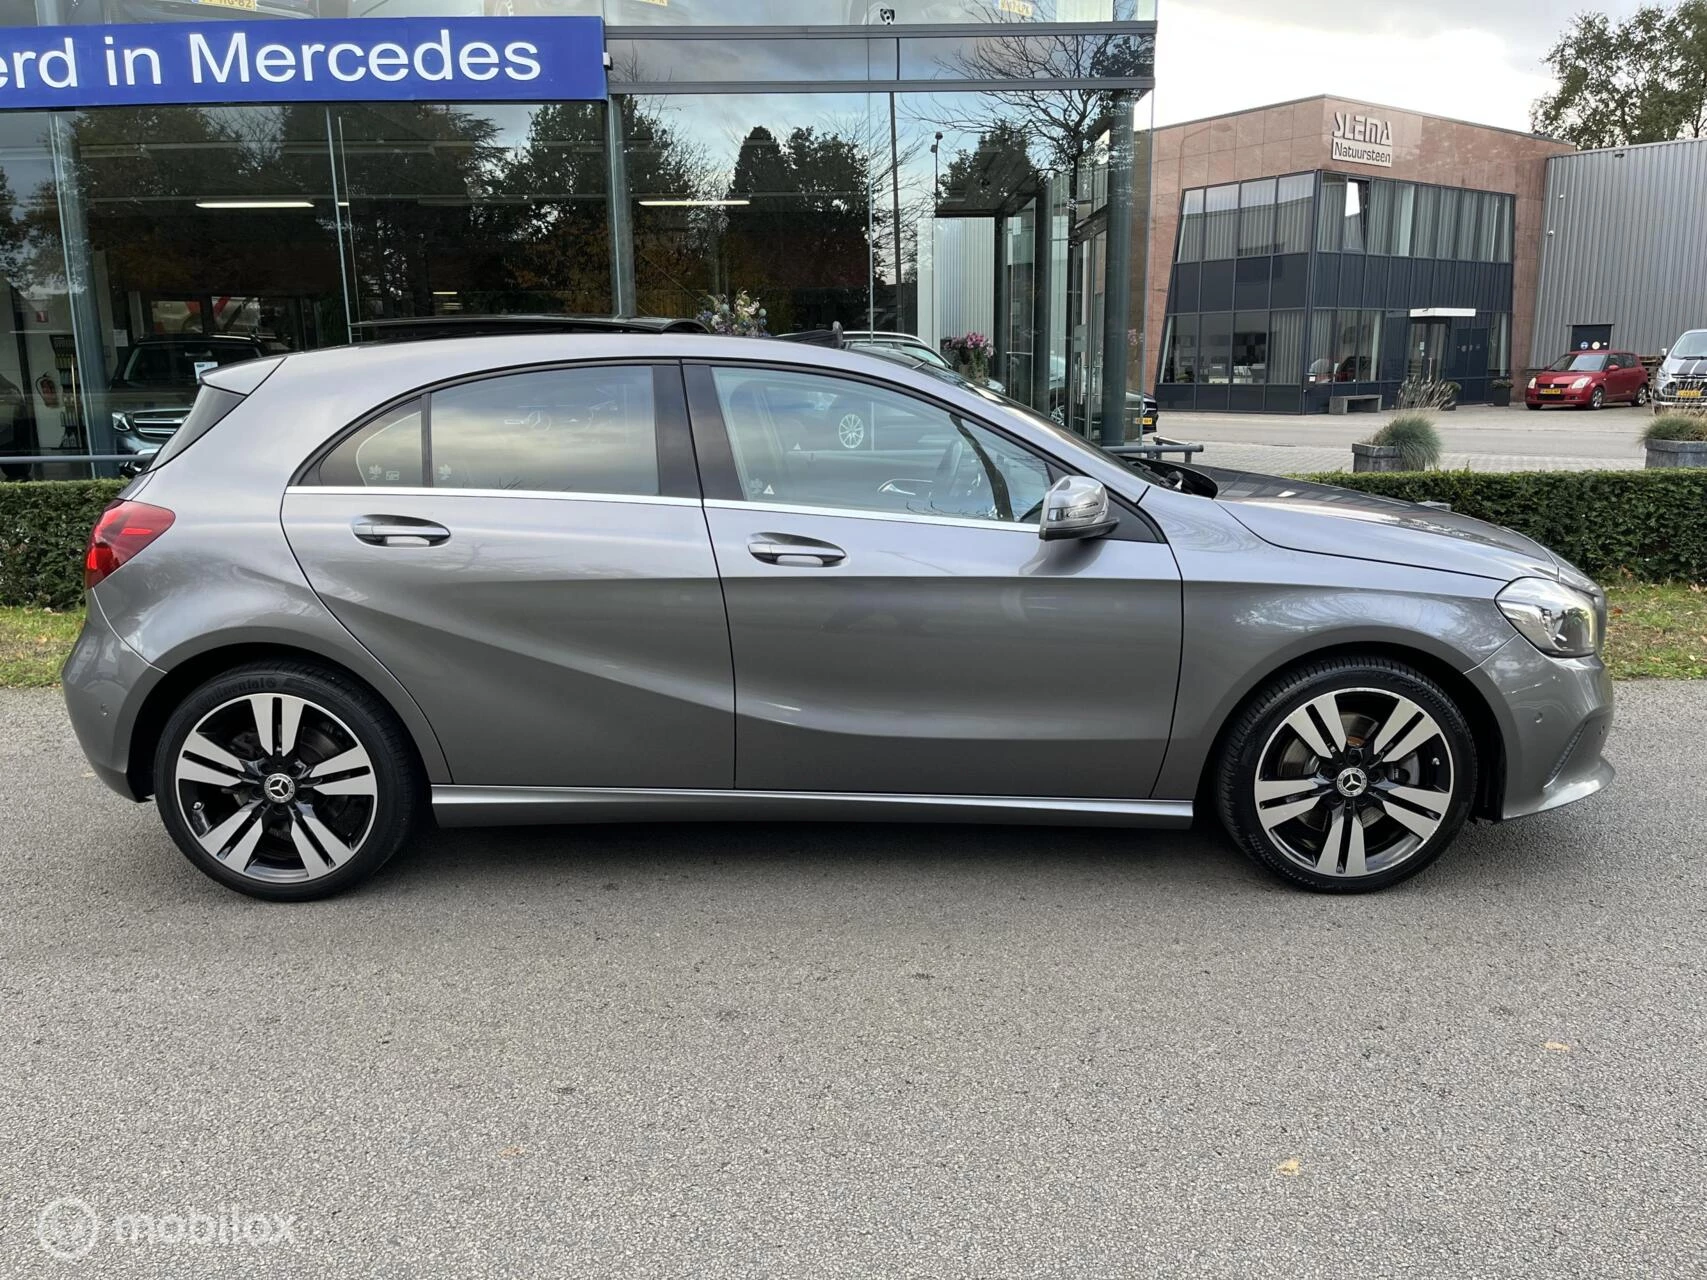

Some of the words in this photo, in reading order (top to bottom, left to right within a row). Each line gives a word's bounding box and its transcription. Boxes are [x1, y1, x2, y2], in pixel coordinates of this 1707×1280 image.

[0, 38, 77, 88] rd
[105, 36, 161, 87] in
[188, 29, 541, 84] Mercedes
[1335, 141, 1391, 164] Natuursteen
